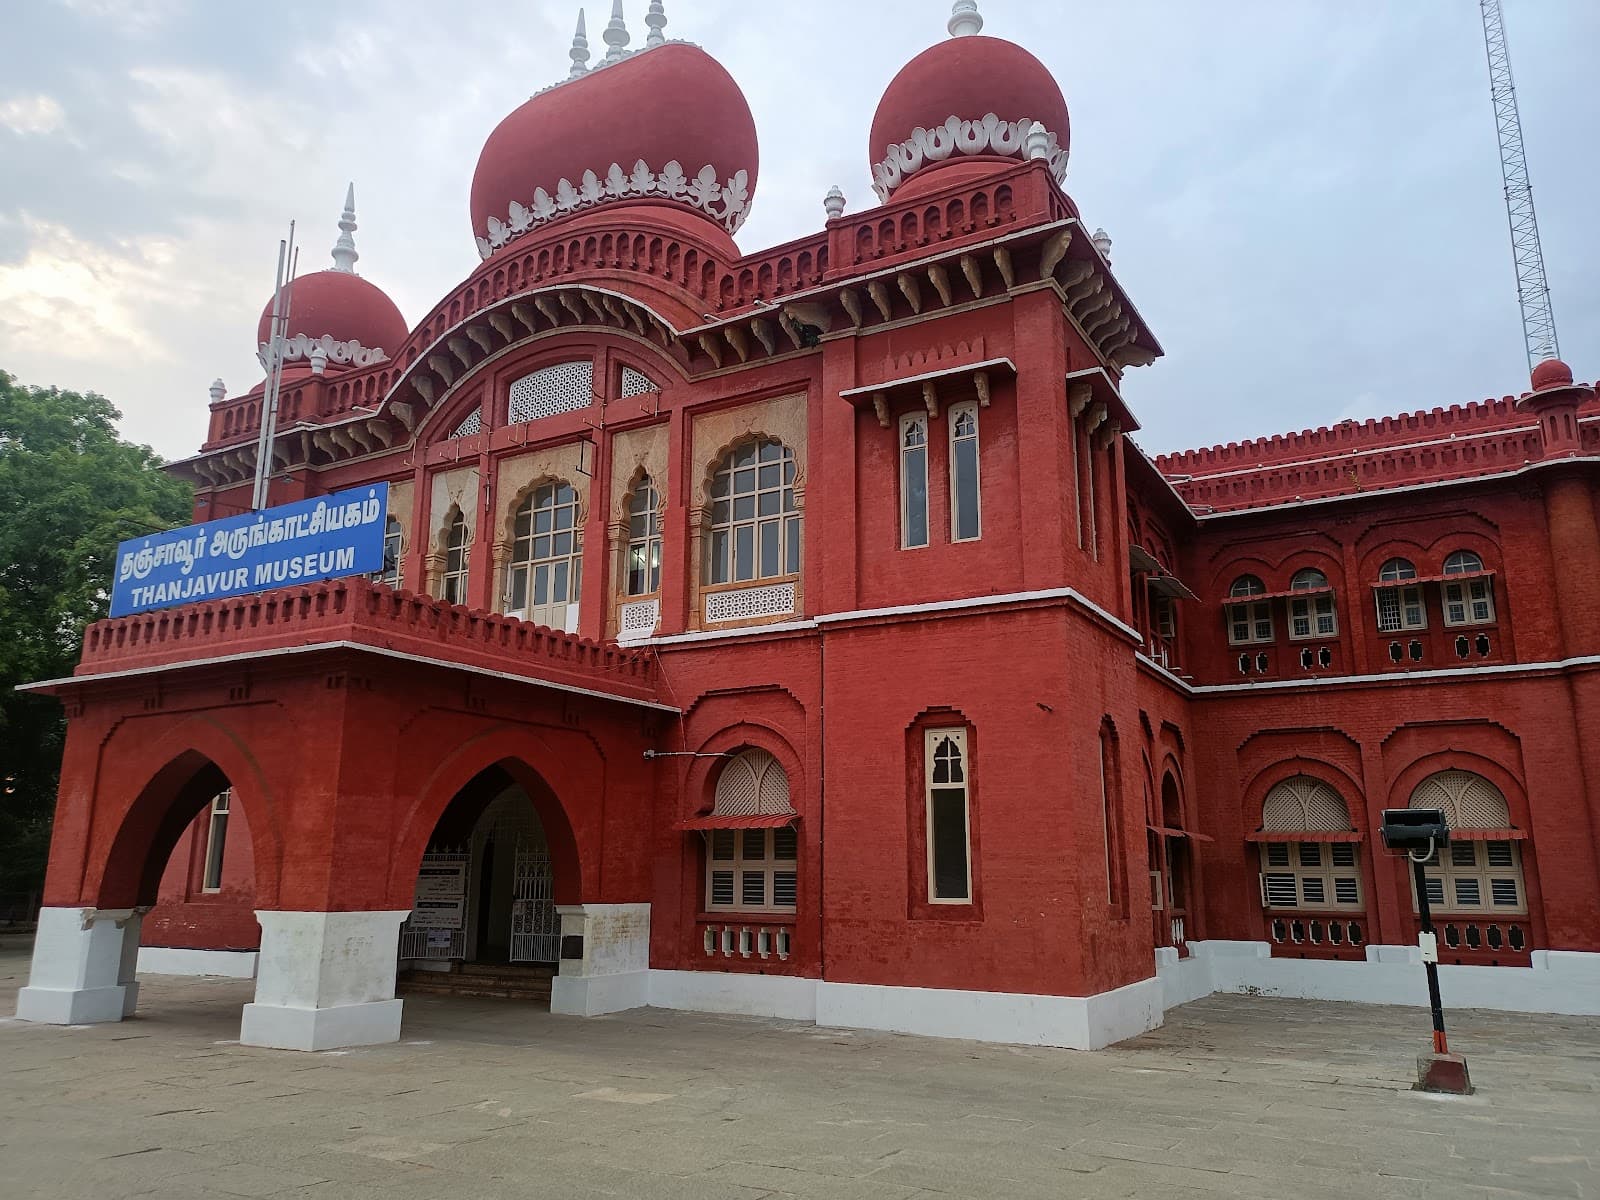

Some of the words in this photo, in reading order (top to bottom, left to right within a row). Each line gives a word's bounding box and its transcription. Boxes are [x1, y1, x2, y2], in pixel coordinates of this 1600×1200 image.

[120, 528, 207, 583] தஞ்சாவூர்
[210, 490, 380, 560] அருங்காட்சியகம்
[131, 568, 249, 608] THANJAVUR
[254, 547, 355, 586] MUSEUM
